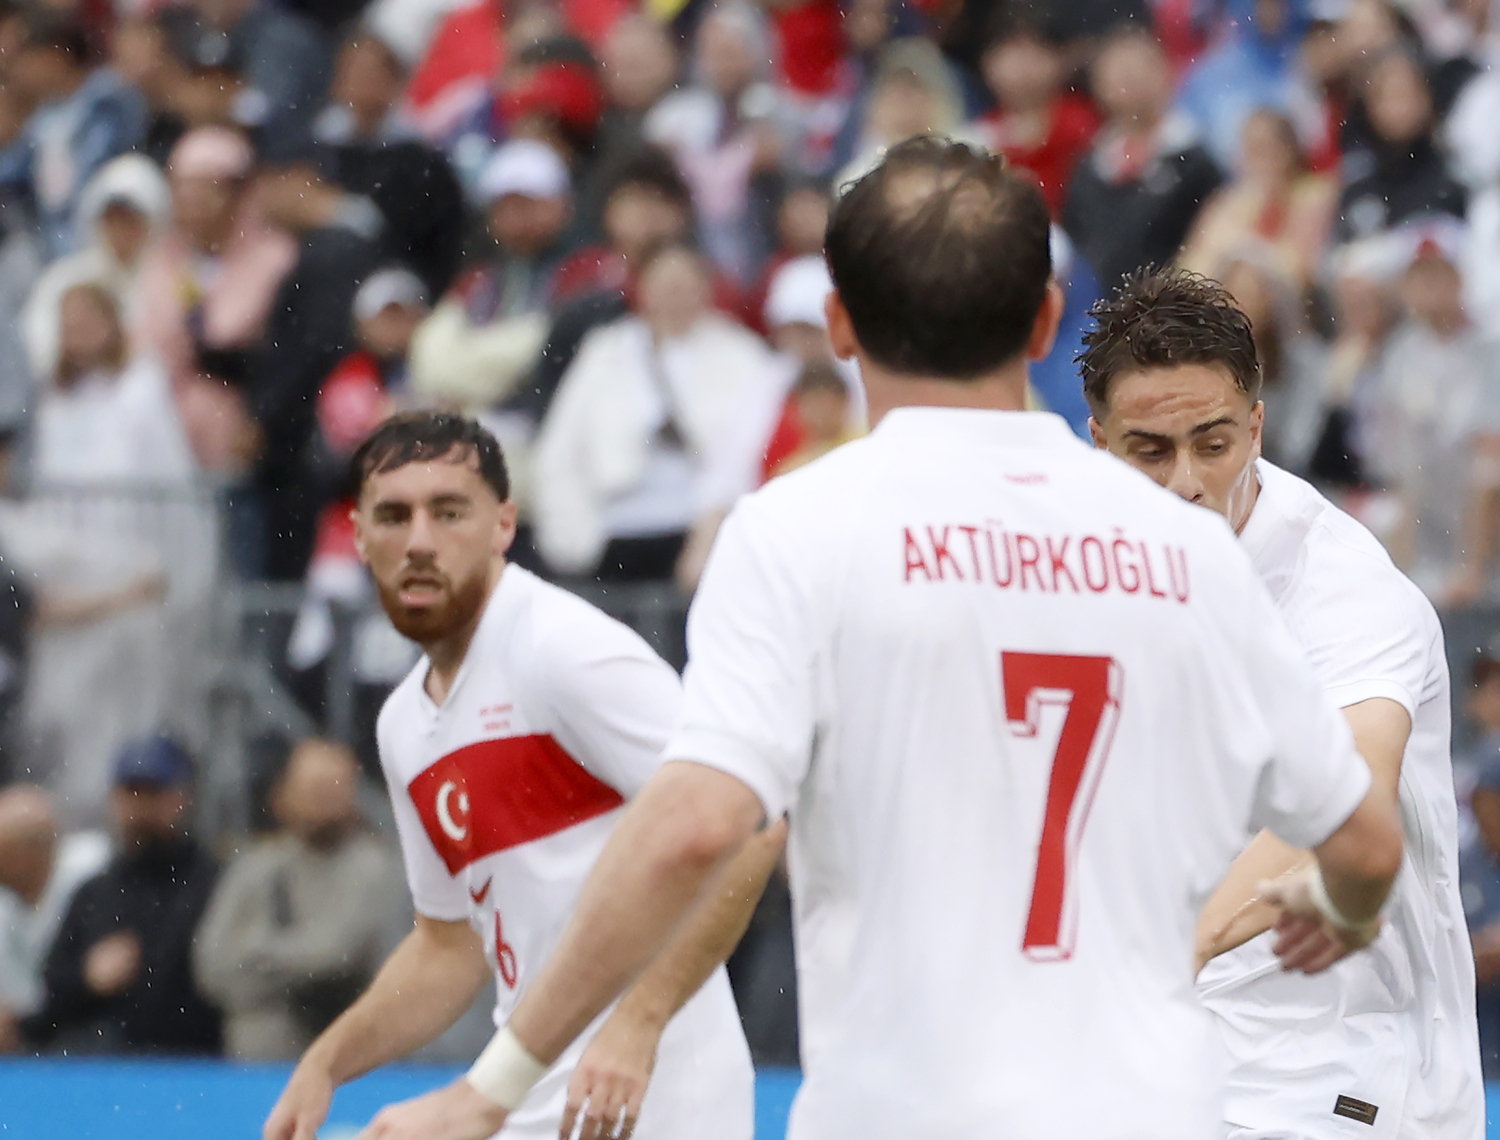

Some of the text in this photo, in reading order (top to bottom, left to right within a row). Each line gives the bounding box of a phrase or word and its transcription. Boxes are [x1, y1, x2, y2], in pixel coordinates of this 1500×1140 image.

[902, 518, 1191, 604] AKTÜRKOĞLU
[999, 650, 1125, 962] 7
[495, 907, 517, 989] 6
